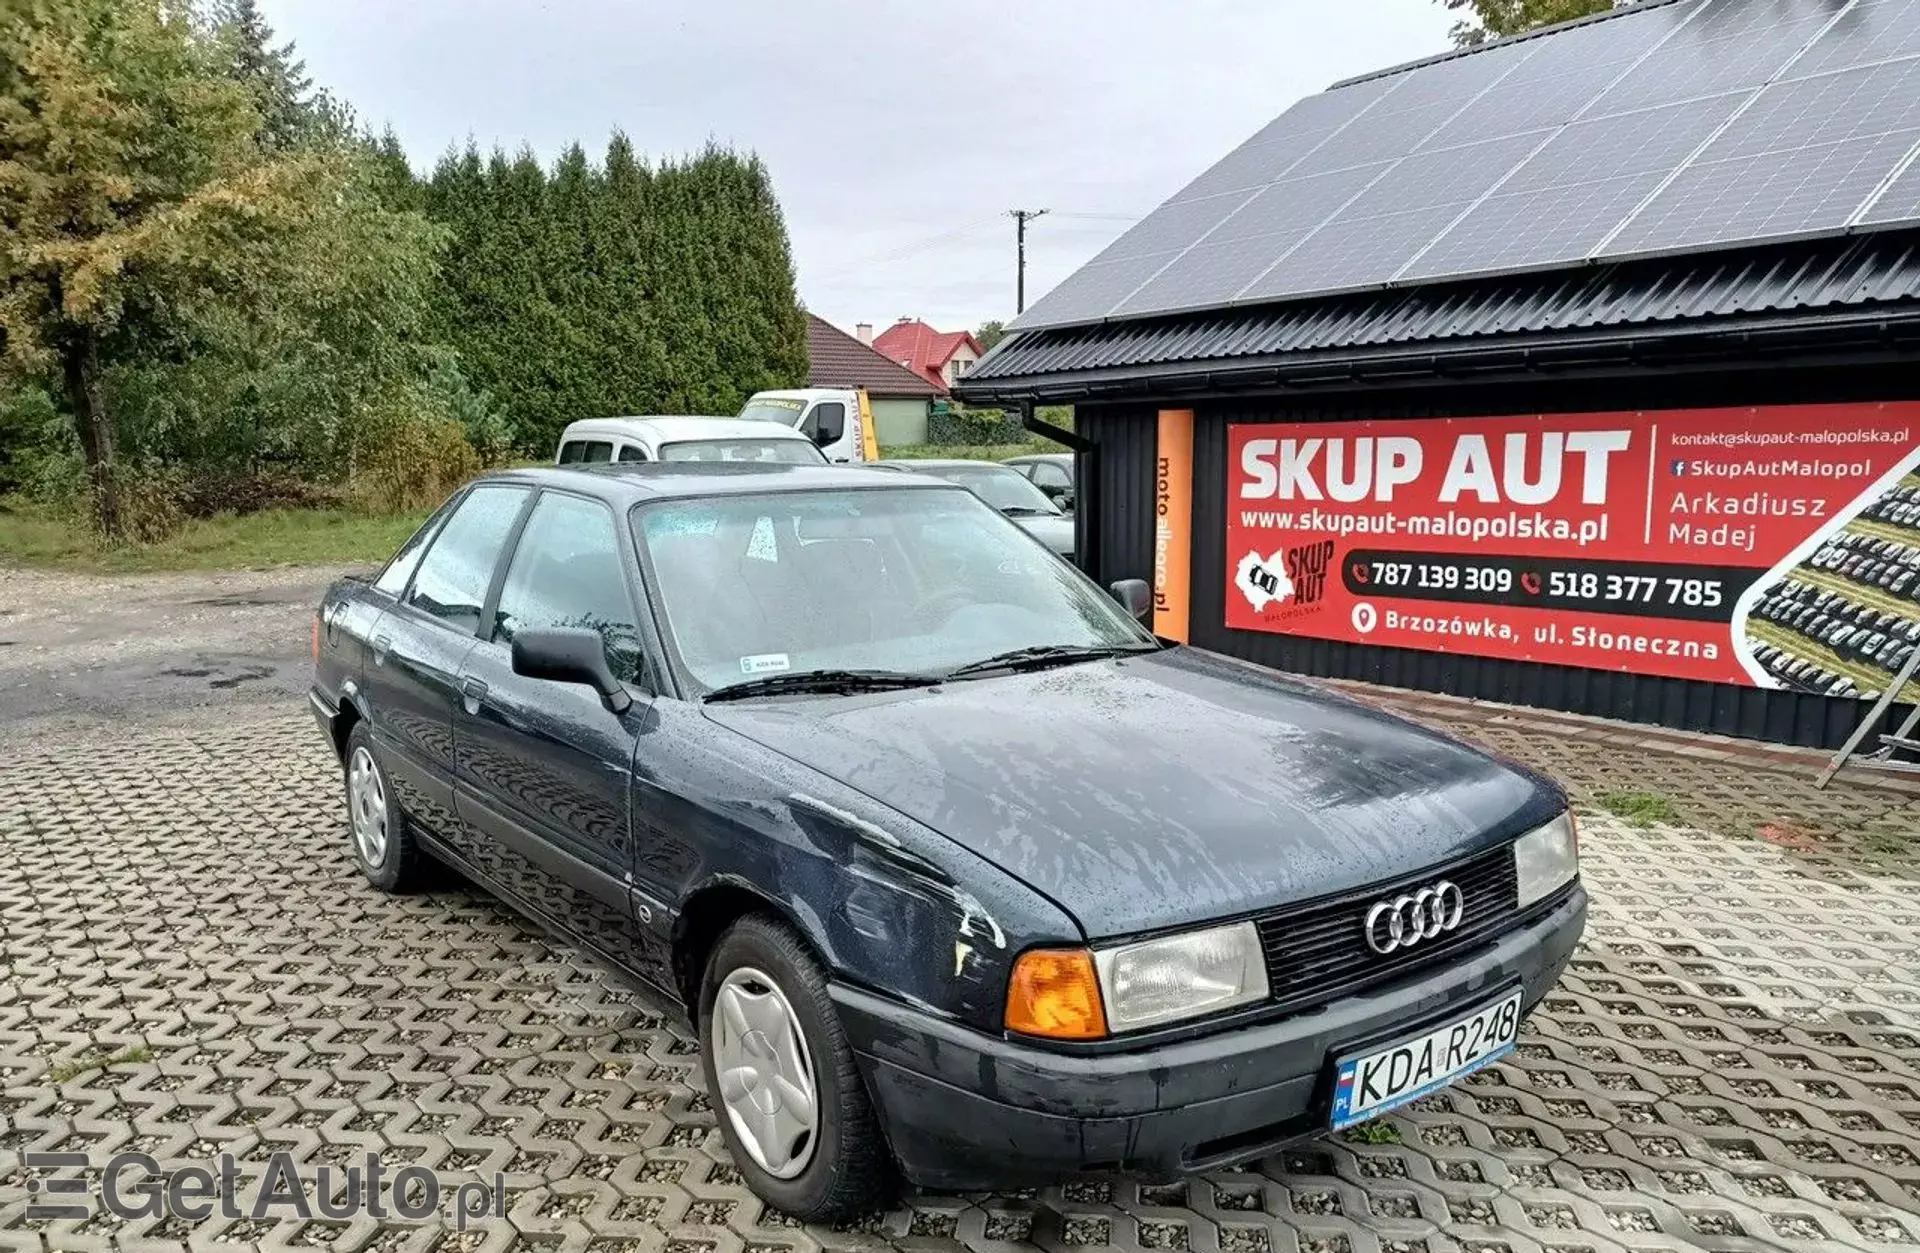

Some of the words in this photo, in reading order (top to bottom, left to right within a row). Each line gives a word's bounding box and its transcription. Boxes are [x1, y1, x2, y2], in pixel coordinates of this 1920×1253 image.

[1671, 428, 1909, 447] kontakt@skupaut-malopolska.pl
[1240, 436, 1423, 503] SKUP
[1438, 430, 1632, 505] AUT
[1690, 459, 1871, 479] SkupAutMalopol
[1670, 492, 1826, 517] Arkadiusz
[1240, 508, 1608, 546] www.skupaut-malopolska.pl
[1668, 523, 1756, 551] Madej
[1288, 540, 1335, 579] SKUP
[1293, 572, 1328, 606] AUT
[1372, 562, 1412, 586] 787
[1418, 565, 1459, 589] 139
[1464, 567, 1512, 593] 309
[1550, 572, 1598, 599] 518
[1605, 575, 1658, 602] 377
[1665, 579, 1722, 607] 785
[1385, 610, 1520, 644] Brzozówka,
[1534, 624, 1564, 644] ul.
[1571, 625, 1719, 660] Słoneczna
[1358, 1038, 1433, 1107] KDA
[1446, 999, 1516, 1071] R248
[1336, 1096, 1349, 1112] PL
